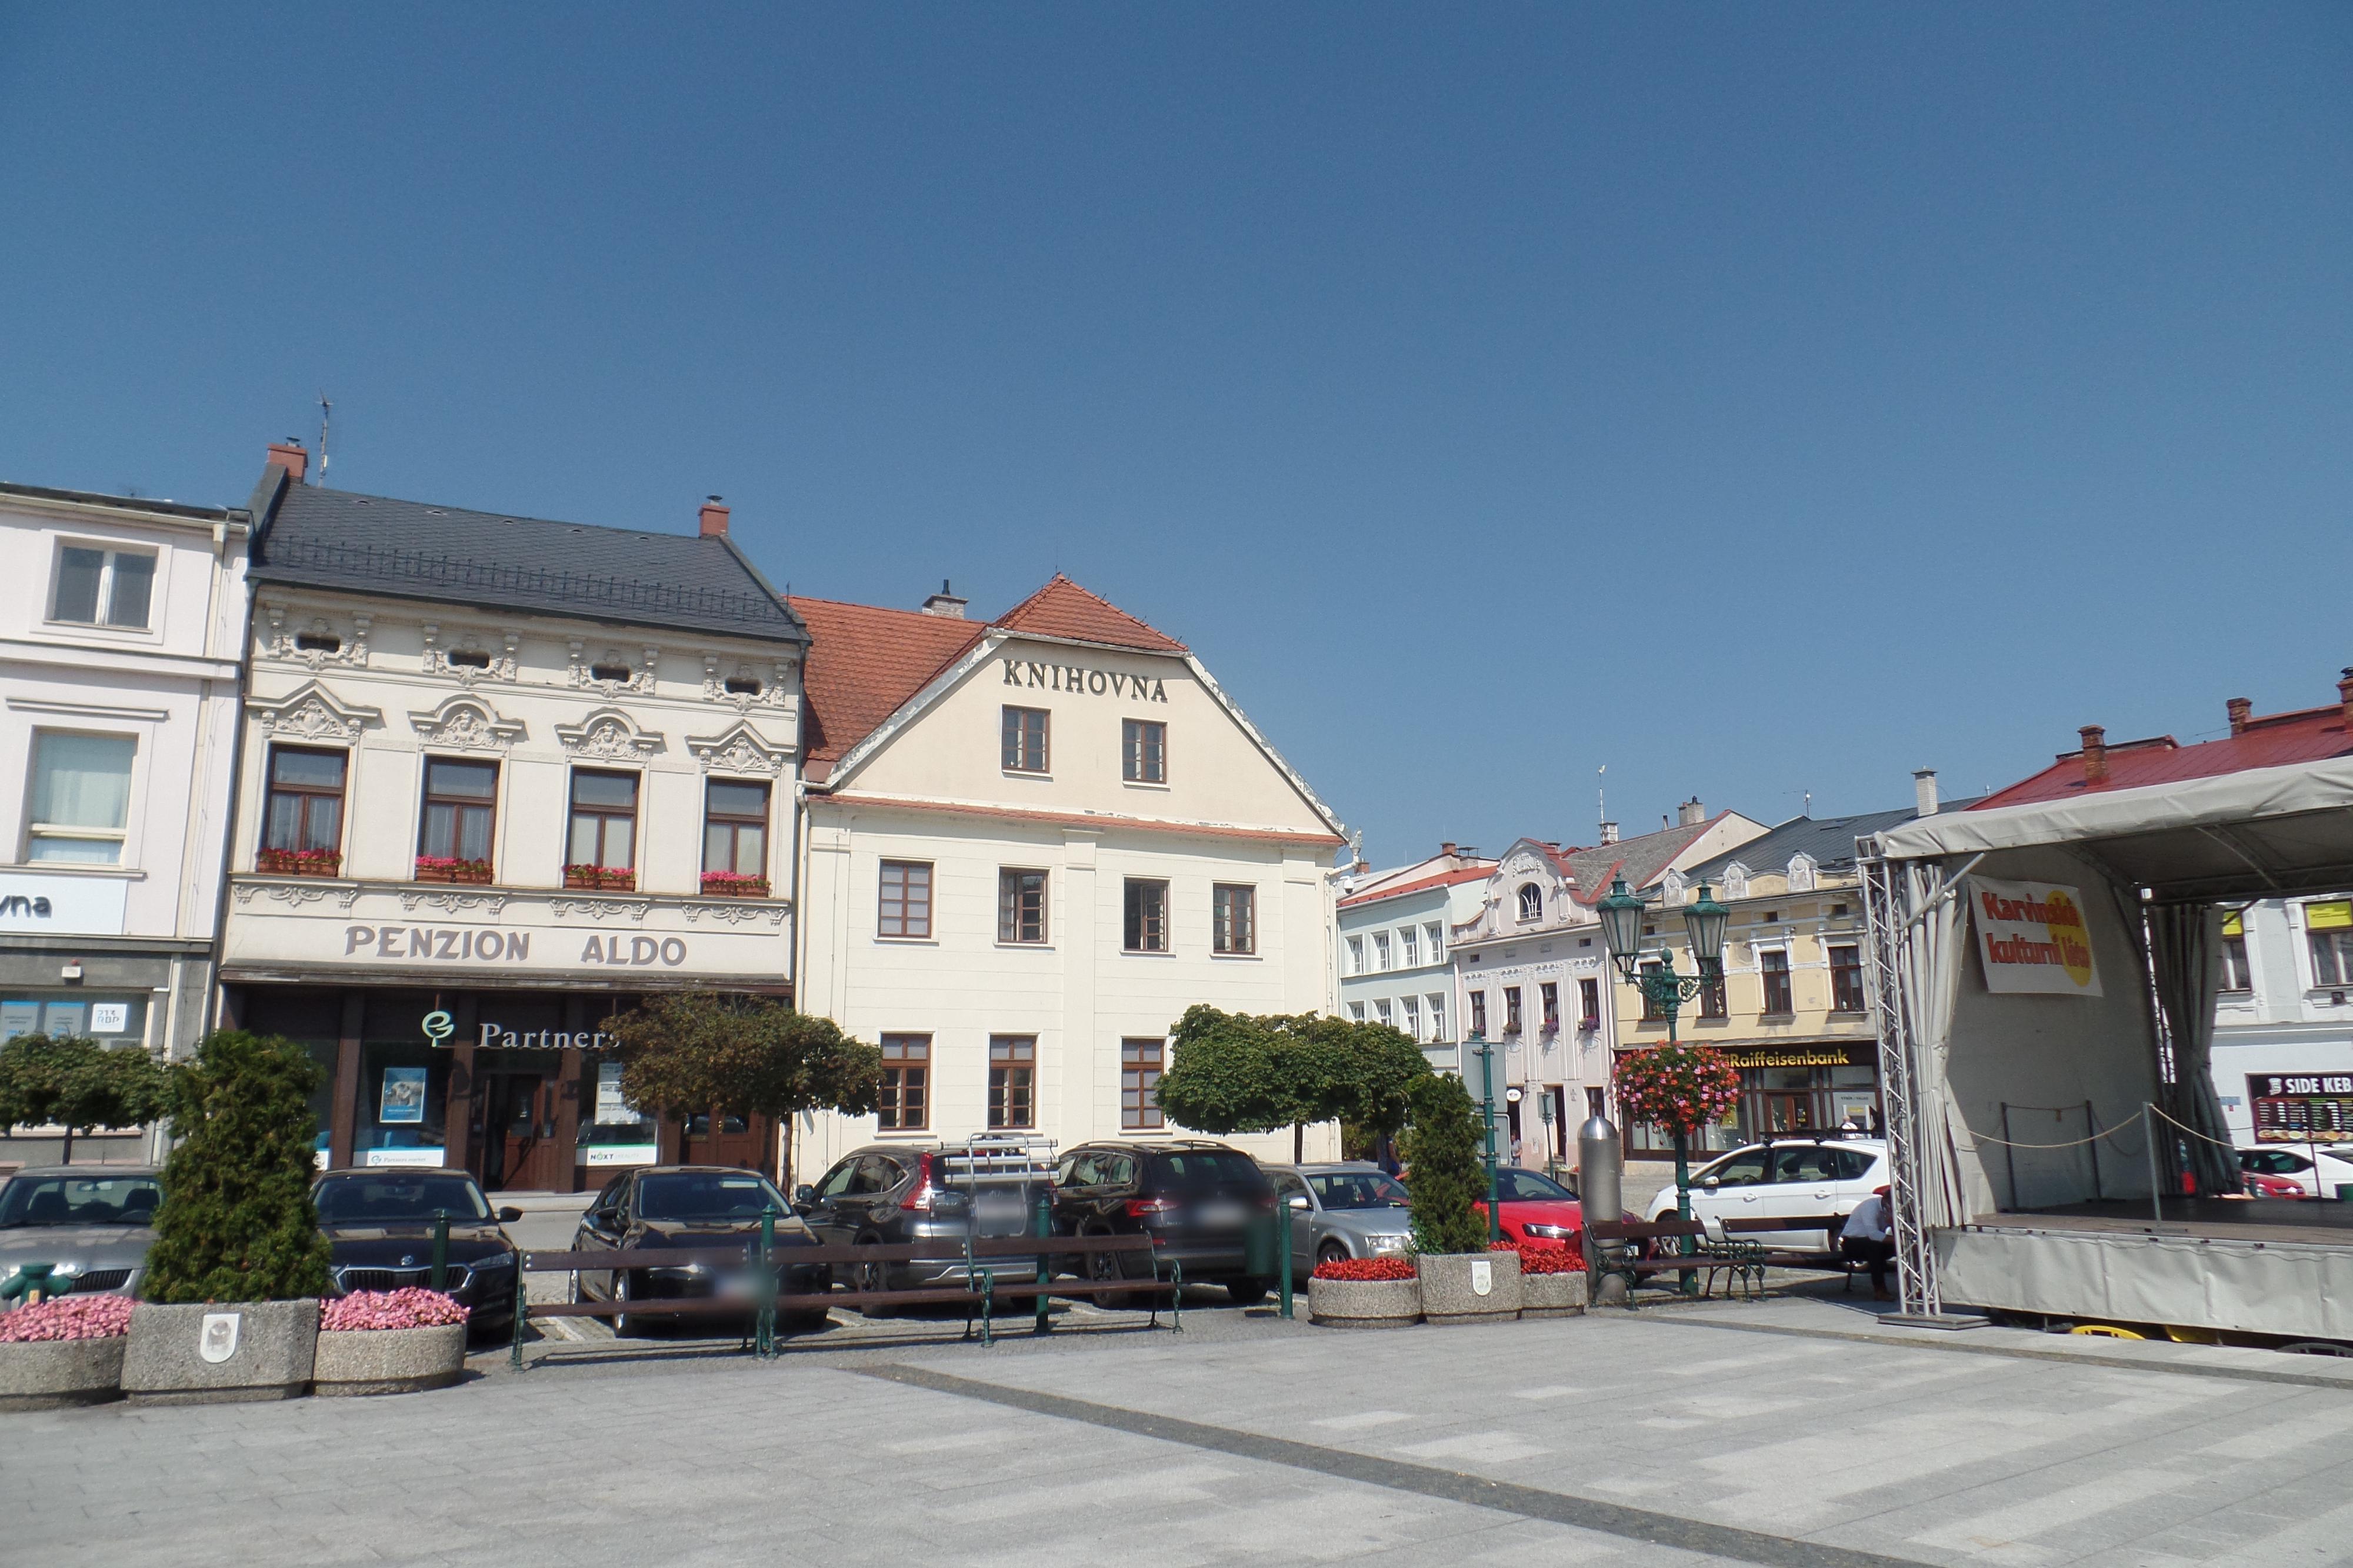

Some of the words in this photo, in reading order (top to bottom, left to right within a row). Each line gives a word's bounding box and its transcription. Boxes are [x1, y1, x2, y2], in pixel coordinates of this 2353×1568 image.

[1003, 659, 1168, 703] KNIHOVNA
[345, 926, 529, 961] PENZION
[580, 935, 687, 966] ALDO
[1729, 1049, 1849, 1067] Raiffeisenbank
[2285, 1078, 2321, 1093] SIDE
